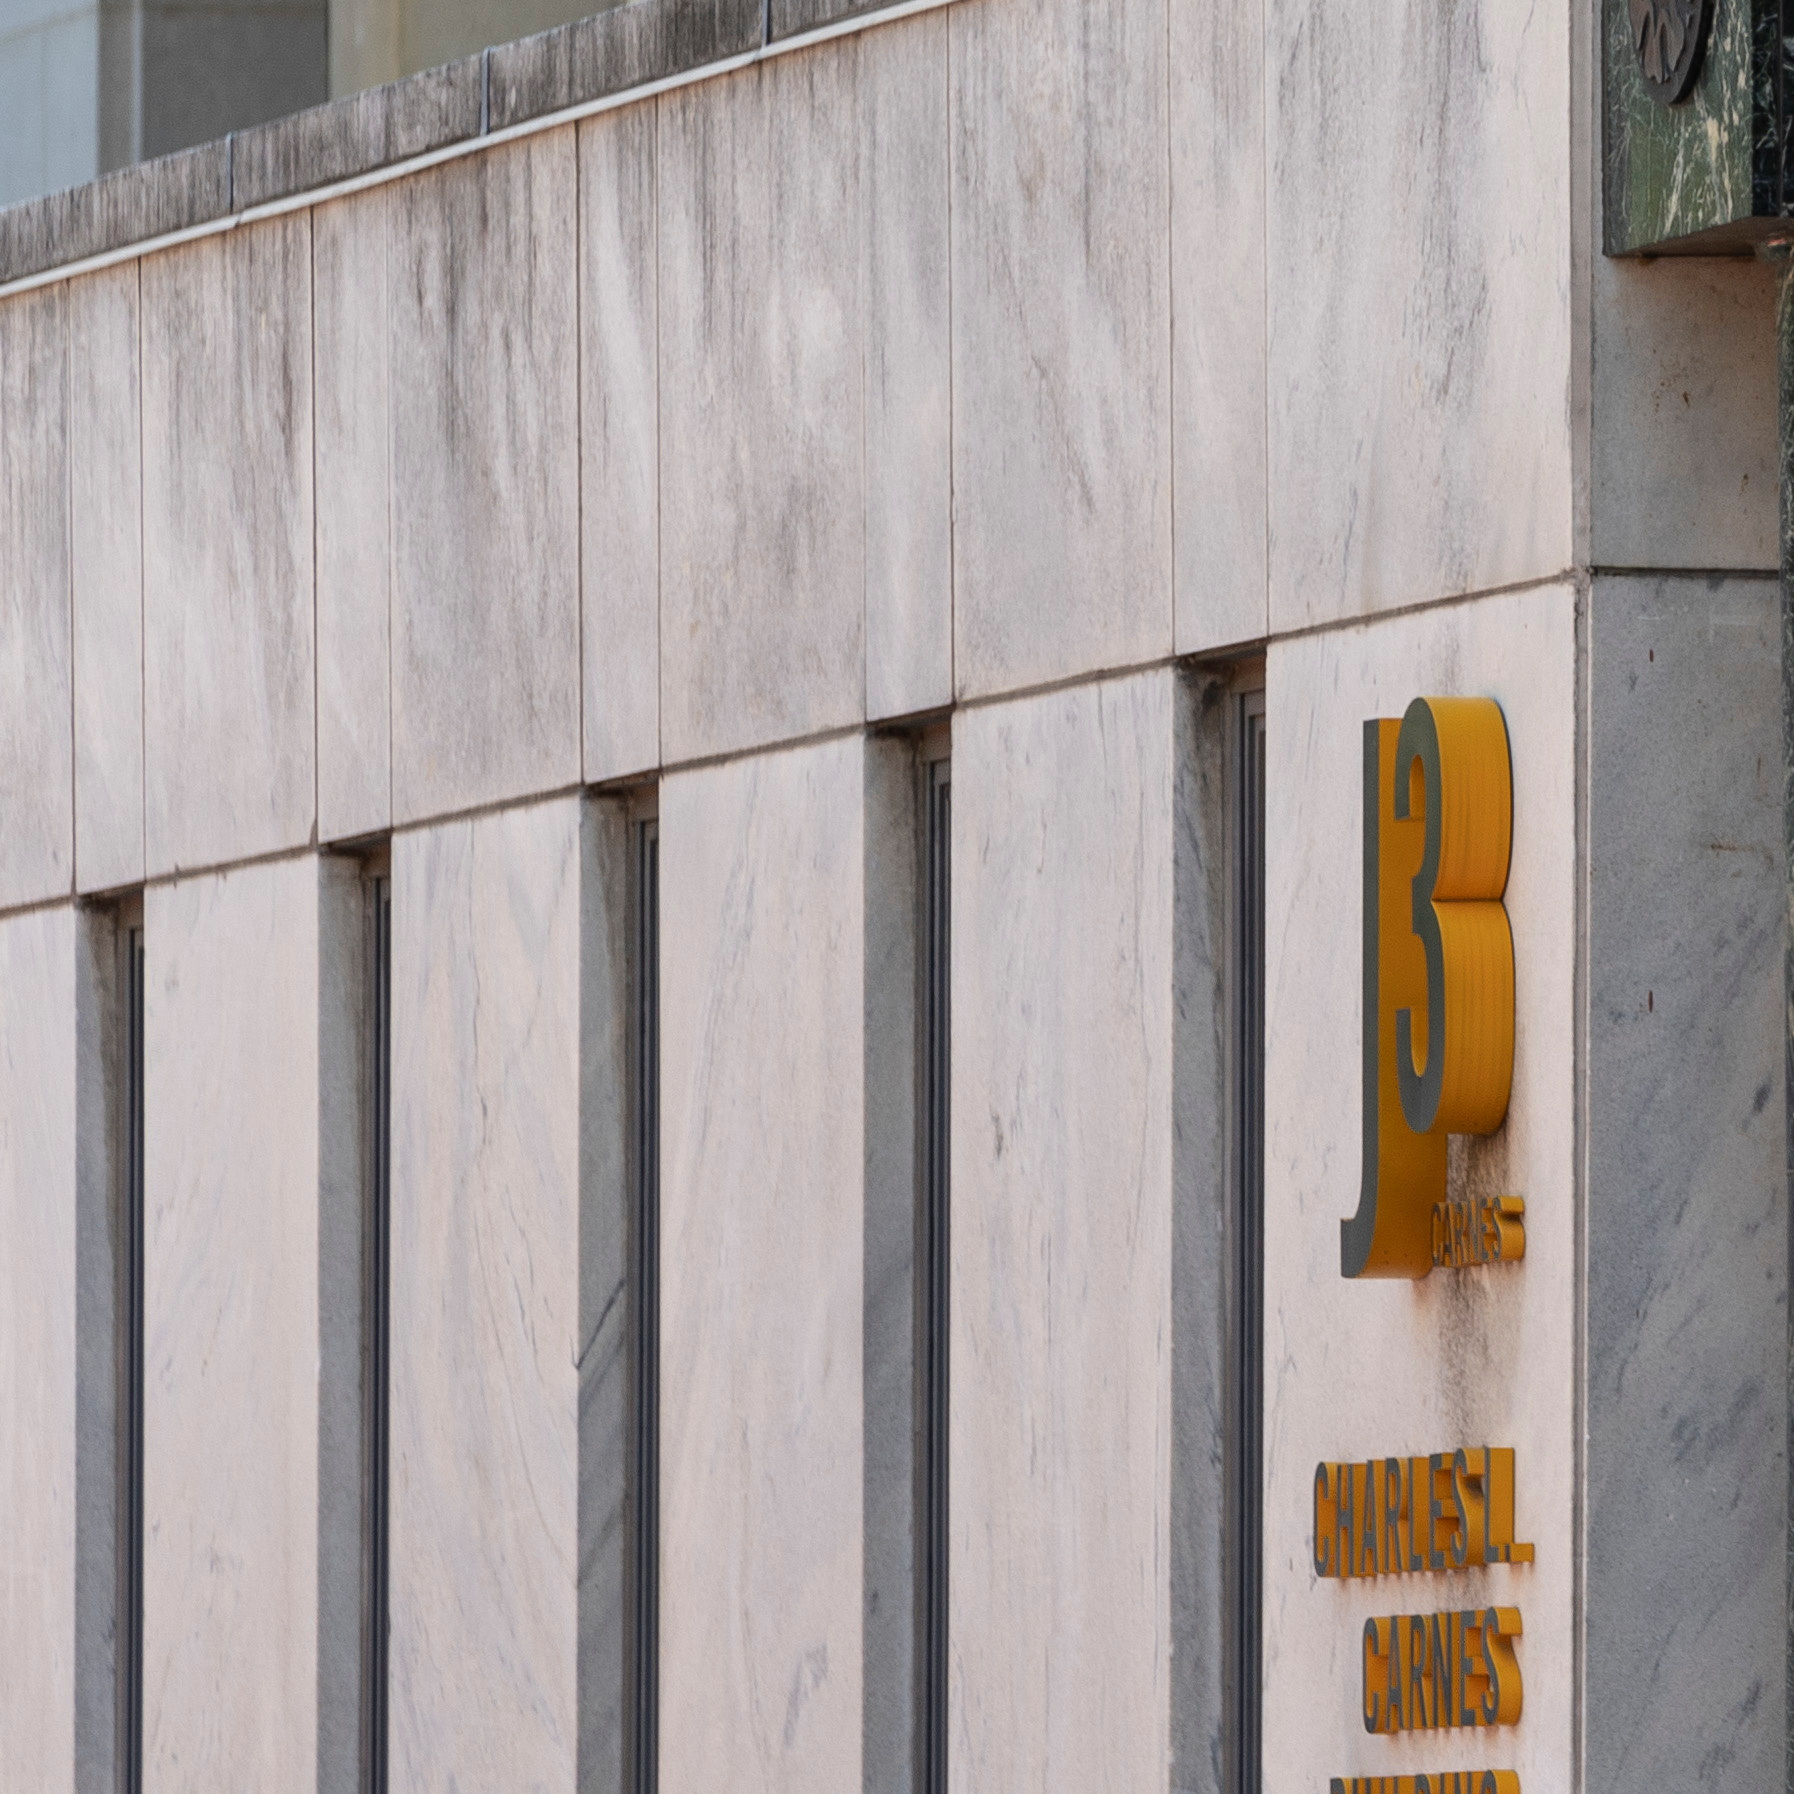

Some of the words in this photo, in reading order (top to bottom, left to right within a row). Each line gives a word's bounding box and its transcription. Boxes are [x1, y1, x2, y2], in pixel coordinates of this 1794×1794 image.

[1431, 1195, 1525, 1267] CARNES
[1314, 1447, 1486, 1577] CHARLES
[1363, 1606, 1523, 1734] CARNES
